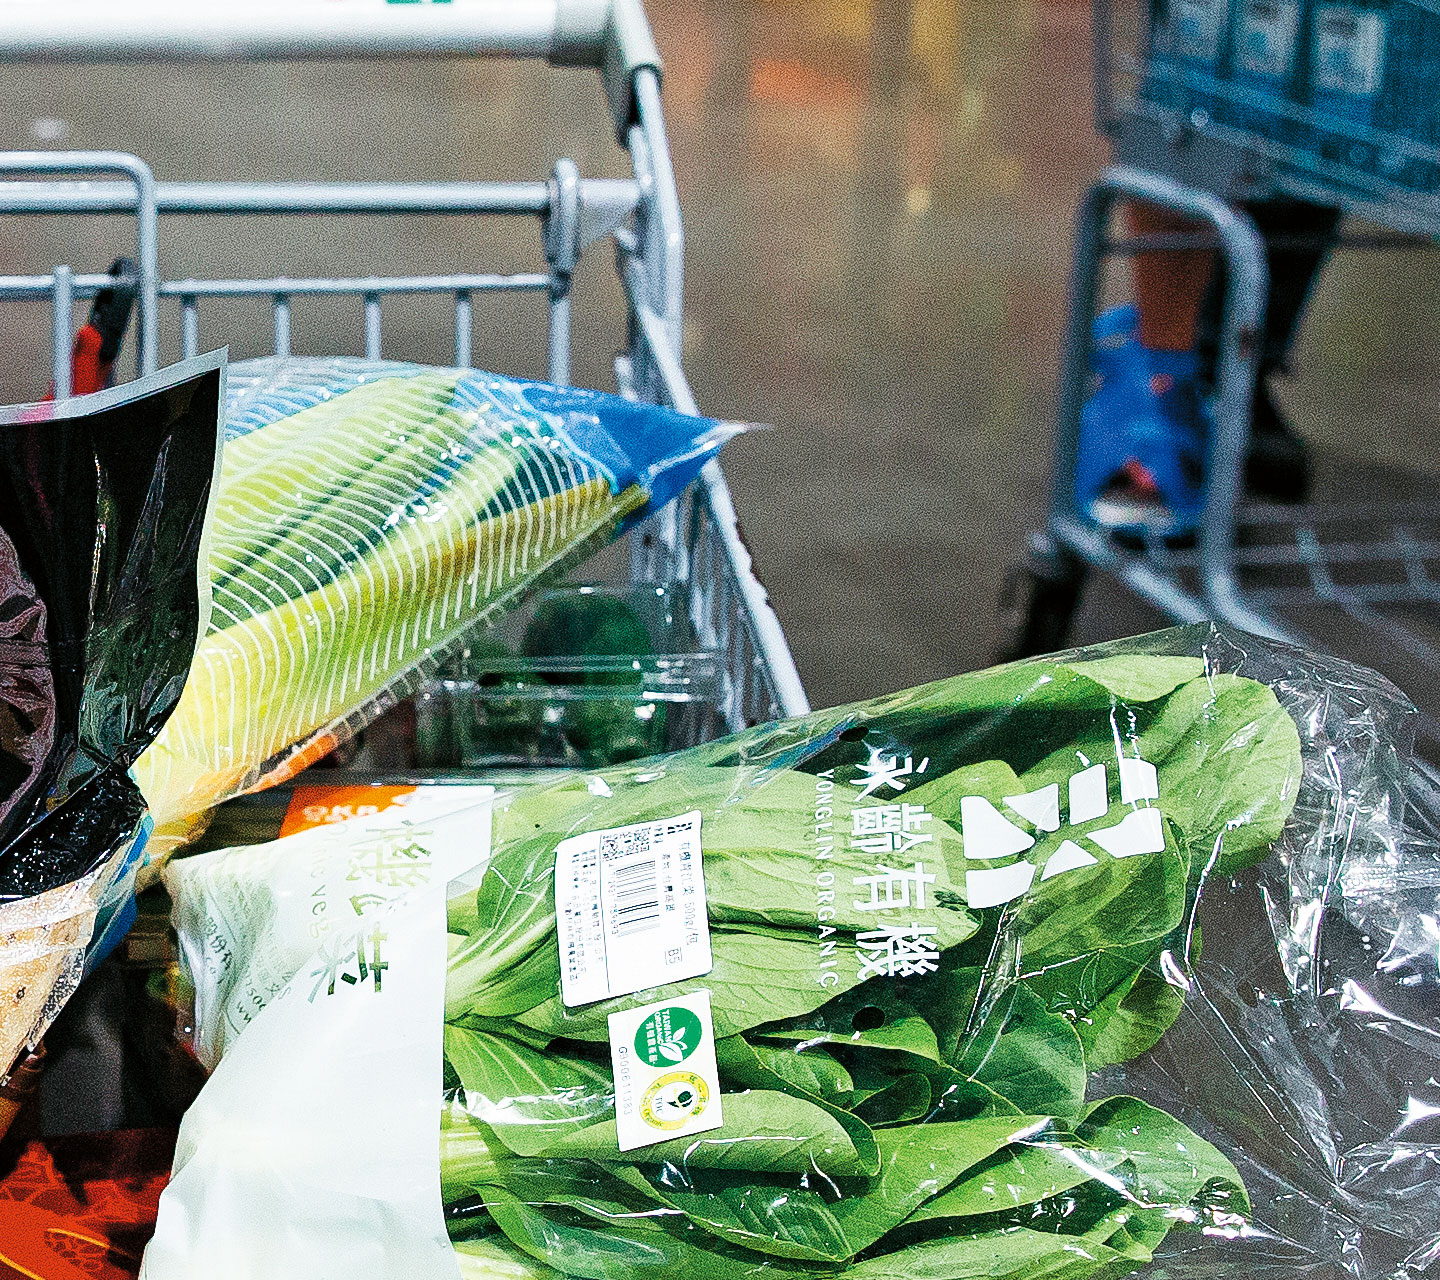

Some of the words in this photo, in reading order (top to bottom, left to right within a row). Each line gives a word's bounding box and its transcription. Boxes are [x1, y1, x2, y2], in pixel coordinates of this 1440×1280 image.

[814, 768, 835, 860] YONGLIN
[849, 748, 940, 982] 永齡有機
[816, 871, 839, 988] ORGANIC
[661, 1009, 672, 1043] TAIWAN
